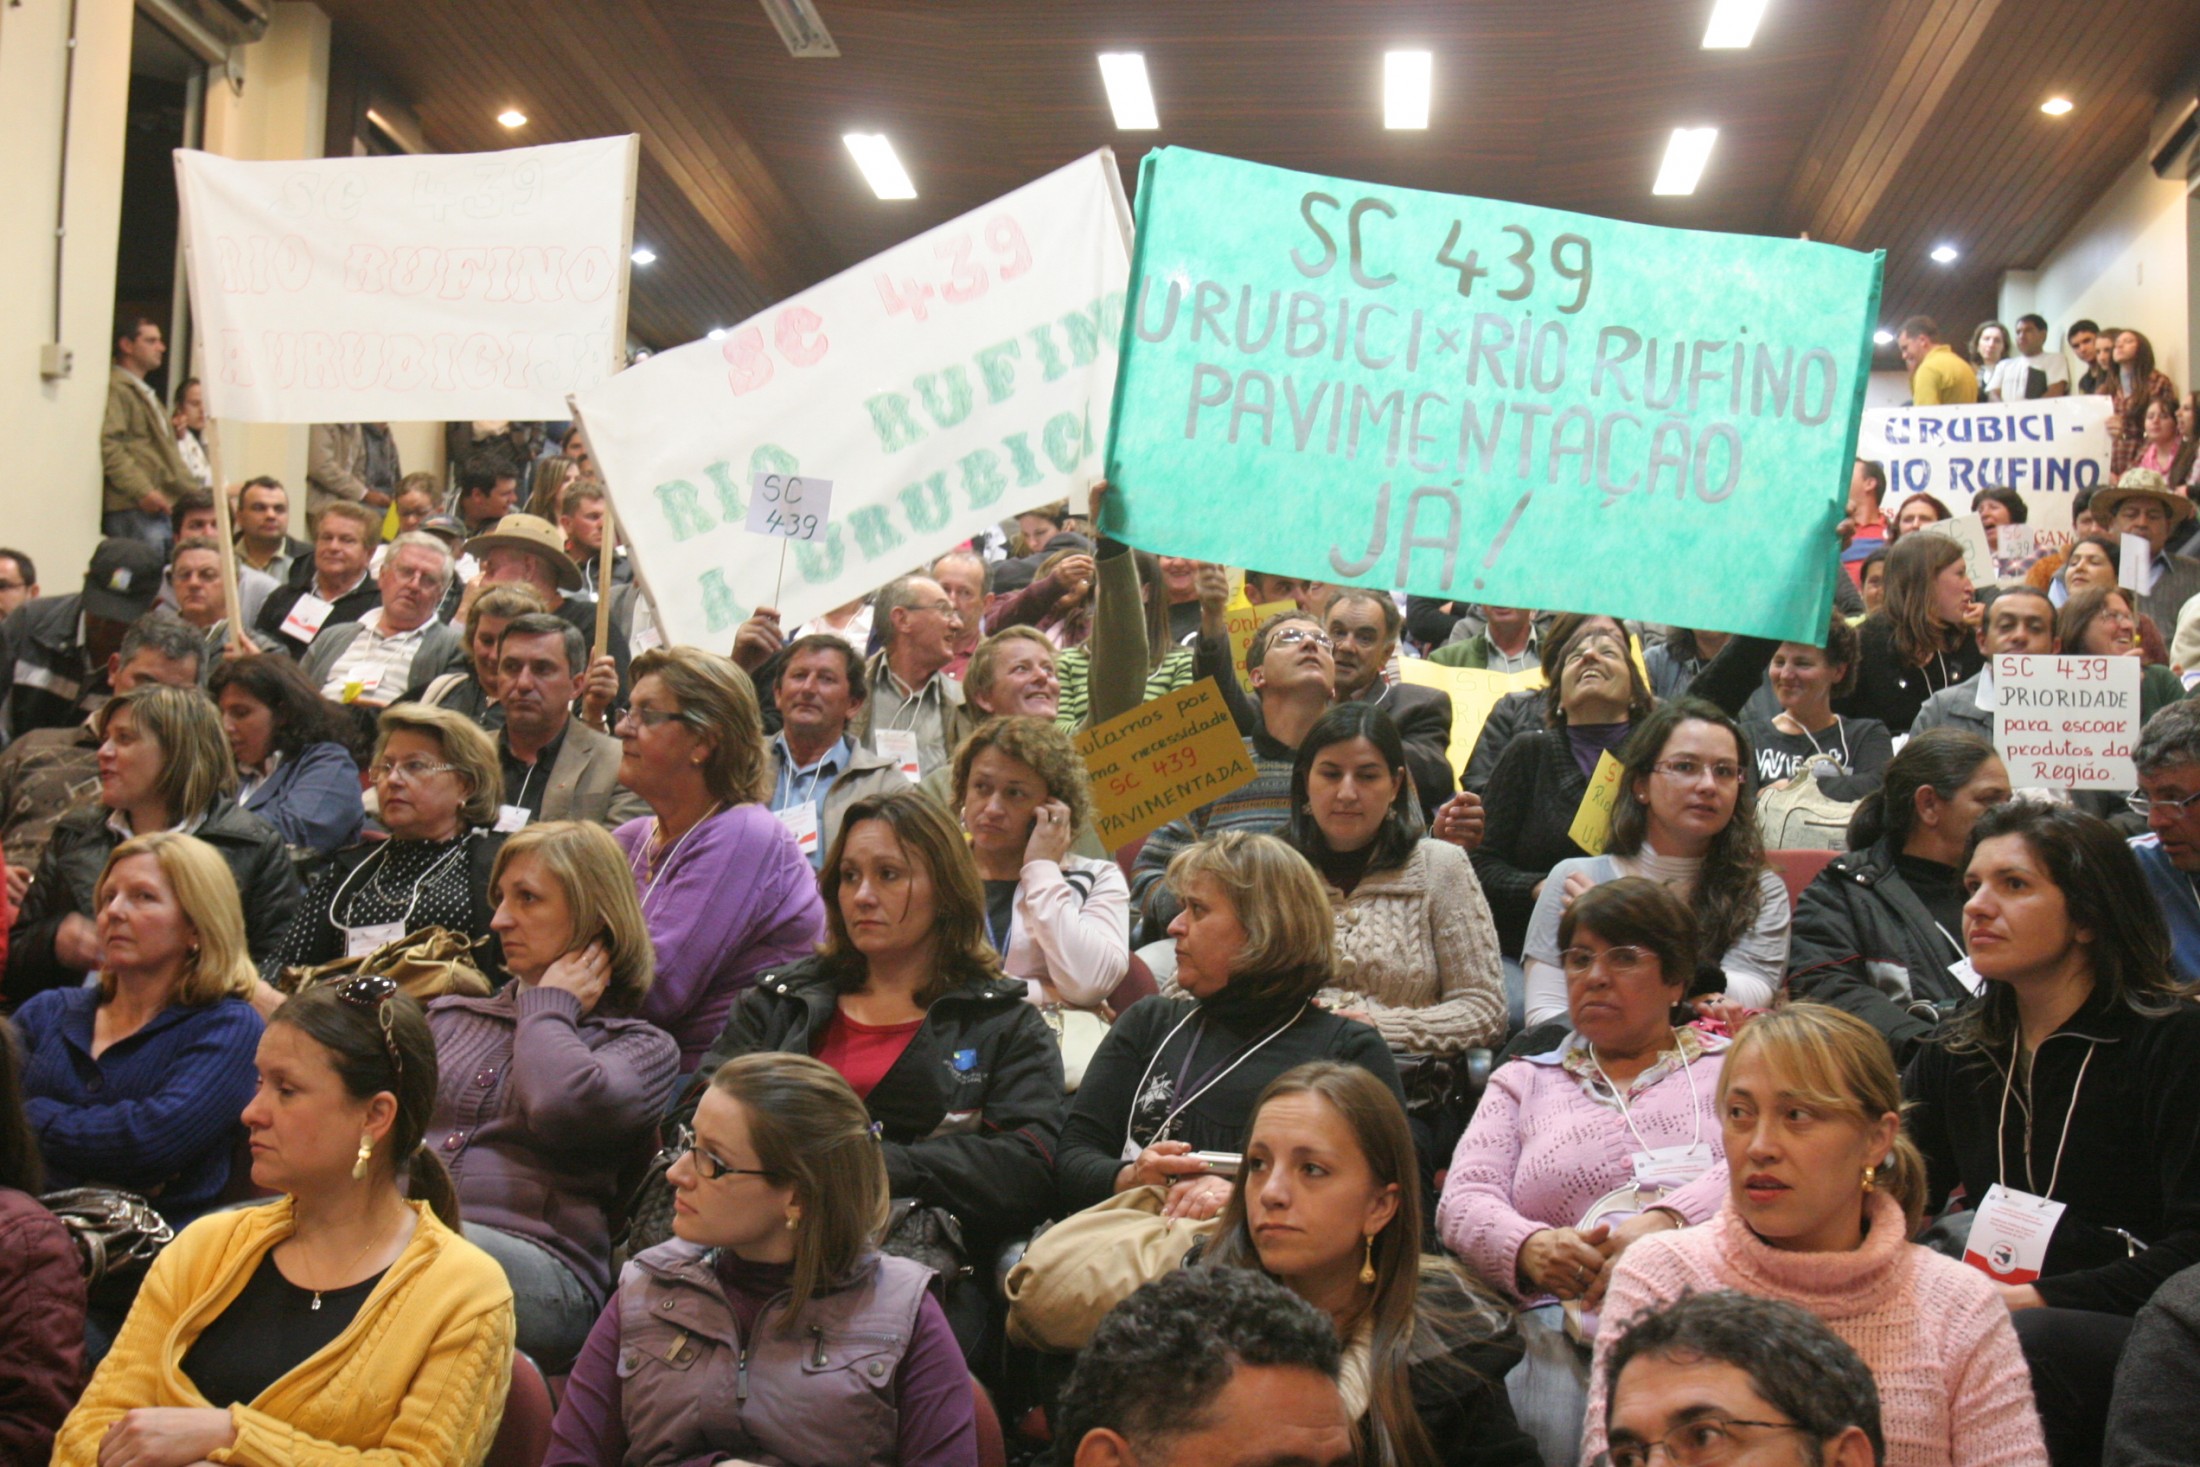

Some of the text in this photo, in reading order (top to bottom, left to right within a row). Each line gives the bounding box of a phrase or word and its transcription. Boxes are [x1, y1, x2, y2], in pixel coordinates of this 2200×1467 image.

[410, 158, 543, 223] 439
[217, 234, 613, 303] RIO RUFINO
[1290, 191, 1594, 315] SC 439
[722, 213, 1033, 397] SC 439
[1136, 275, 1420, 372] URUBICI
[1184, 362, 1742, 508] PAVIMENTAÇÃO
[1885, 414, 2054, 447] URUBICI
[763, 475, 802, 504] SC
[1877, 457, 2100, 493] IO RUFINO
[766, 509, 817, 539] 439
[698, 567, 750, 633] A
[2001, 657, 2108, 681] SC 439
[2000, 686, 2128, 708] PRIORIDADE
[1081, 709, 1163, 757] utamos
[1131, 711, 1228, 763] necessidade
[2004, 719, 2127, 735] para escoar
[2006, 739, 2132, 761] produtos da
[1110, 746, 1198, 796] SC 439
[2032, 760, 2116, 788] Região.
